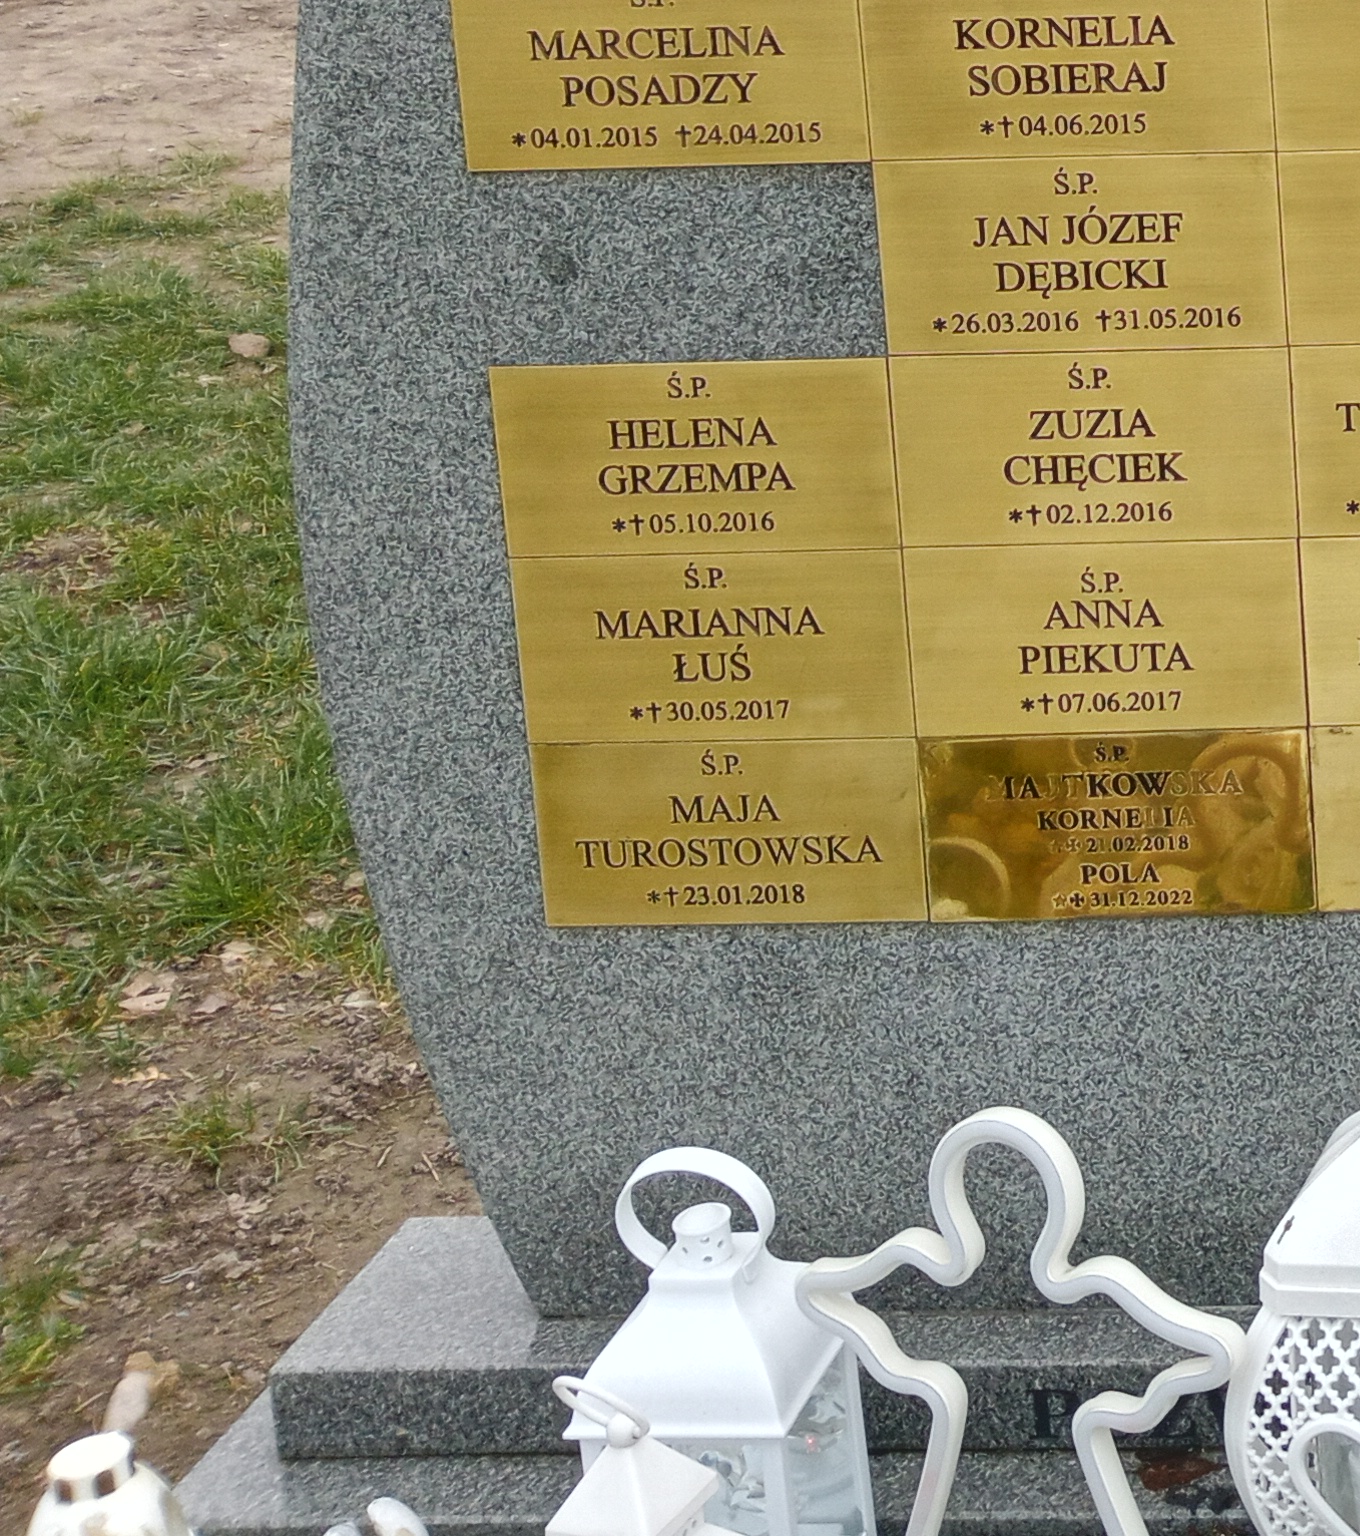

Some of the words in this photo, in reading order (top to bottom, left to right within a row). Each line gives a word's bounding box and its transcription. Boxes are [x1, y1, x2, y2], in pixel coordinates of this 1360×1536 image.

[526, 25, 786, 61] MARCELINA
[952, 14, 1176, 50] KORNELIA
[559, 72, 758, 108] POSADZY
[968, 61, 1168, 97] SOBIERAJ
[1053, 166, 1098, 195] Ś.P.
[972, 215, 1050, 248] JAN
[1061, 205, 1183, 245] JÓZEF
[992, 259, 1169, 300] DĘBICKI
[667, 370, 711, 399] Ś.P.
[1067, 361, 1112, 390] Ś.P.
[606, 416, 778, 450] HELENA
[1028, 408, 1157, 440] ZUZIA
[598, 461, 796, 496] GRZEMPA
[1003, 452, 1188, 492] CHĘCIEK
[684, 561, 727, 590] Ś.P.
[1080, 566, 1124, 594] Ś.P.
[593, 606, 825, 640] MARIANNA
[1043, 598, 1165, 630] ANNA
[672, 643, 751, 683] ŁUŚ
[1017, 642, 1195, 675] PIEKUTA
[701, 748, 743, 776] Ś.P.
[1094, 742, 1129, 763] Ś.P.
[668, 794, 781, 824] MAJA
[1037, 806, 1195, 830] KORNELIA
[574, 834, 883, 869] TUROSTOWSKA
[1080, 863, 1160, 884] POLA
